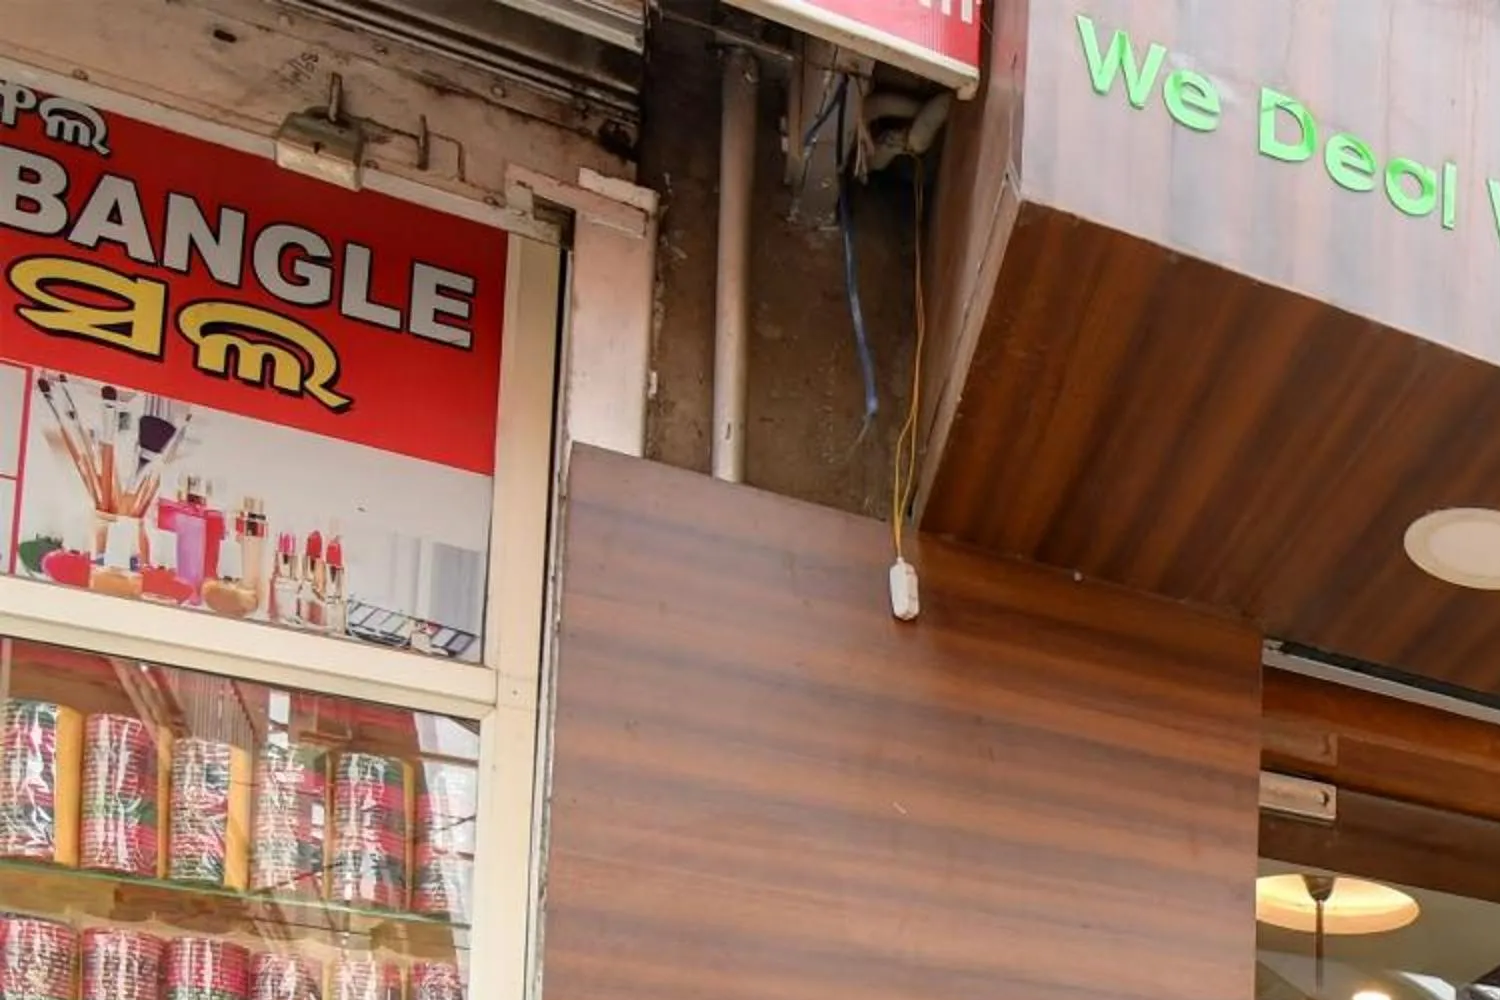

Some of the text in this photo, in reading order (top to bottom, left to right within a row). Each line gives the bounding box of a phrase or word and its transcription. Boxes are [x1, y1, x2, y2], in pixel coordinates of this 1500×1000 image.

[1075, 14, 1222, 132] We
[1257, 86, 1458, 230] Deal
[0, 144, 476, 351] BANGLE
